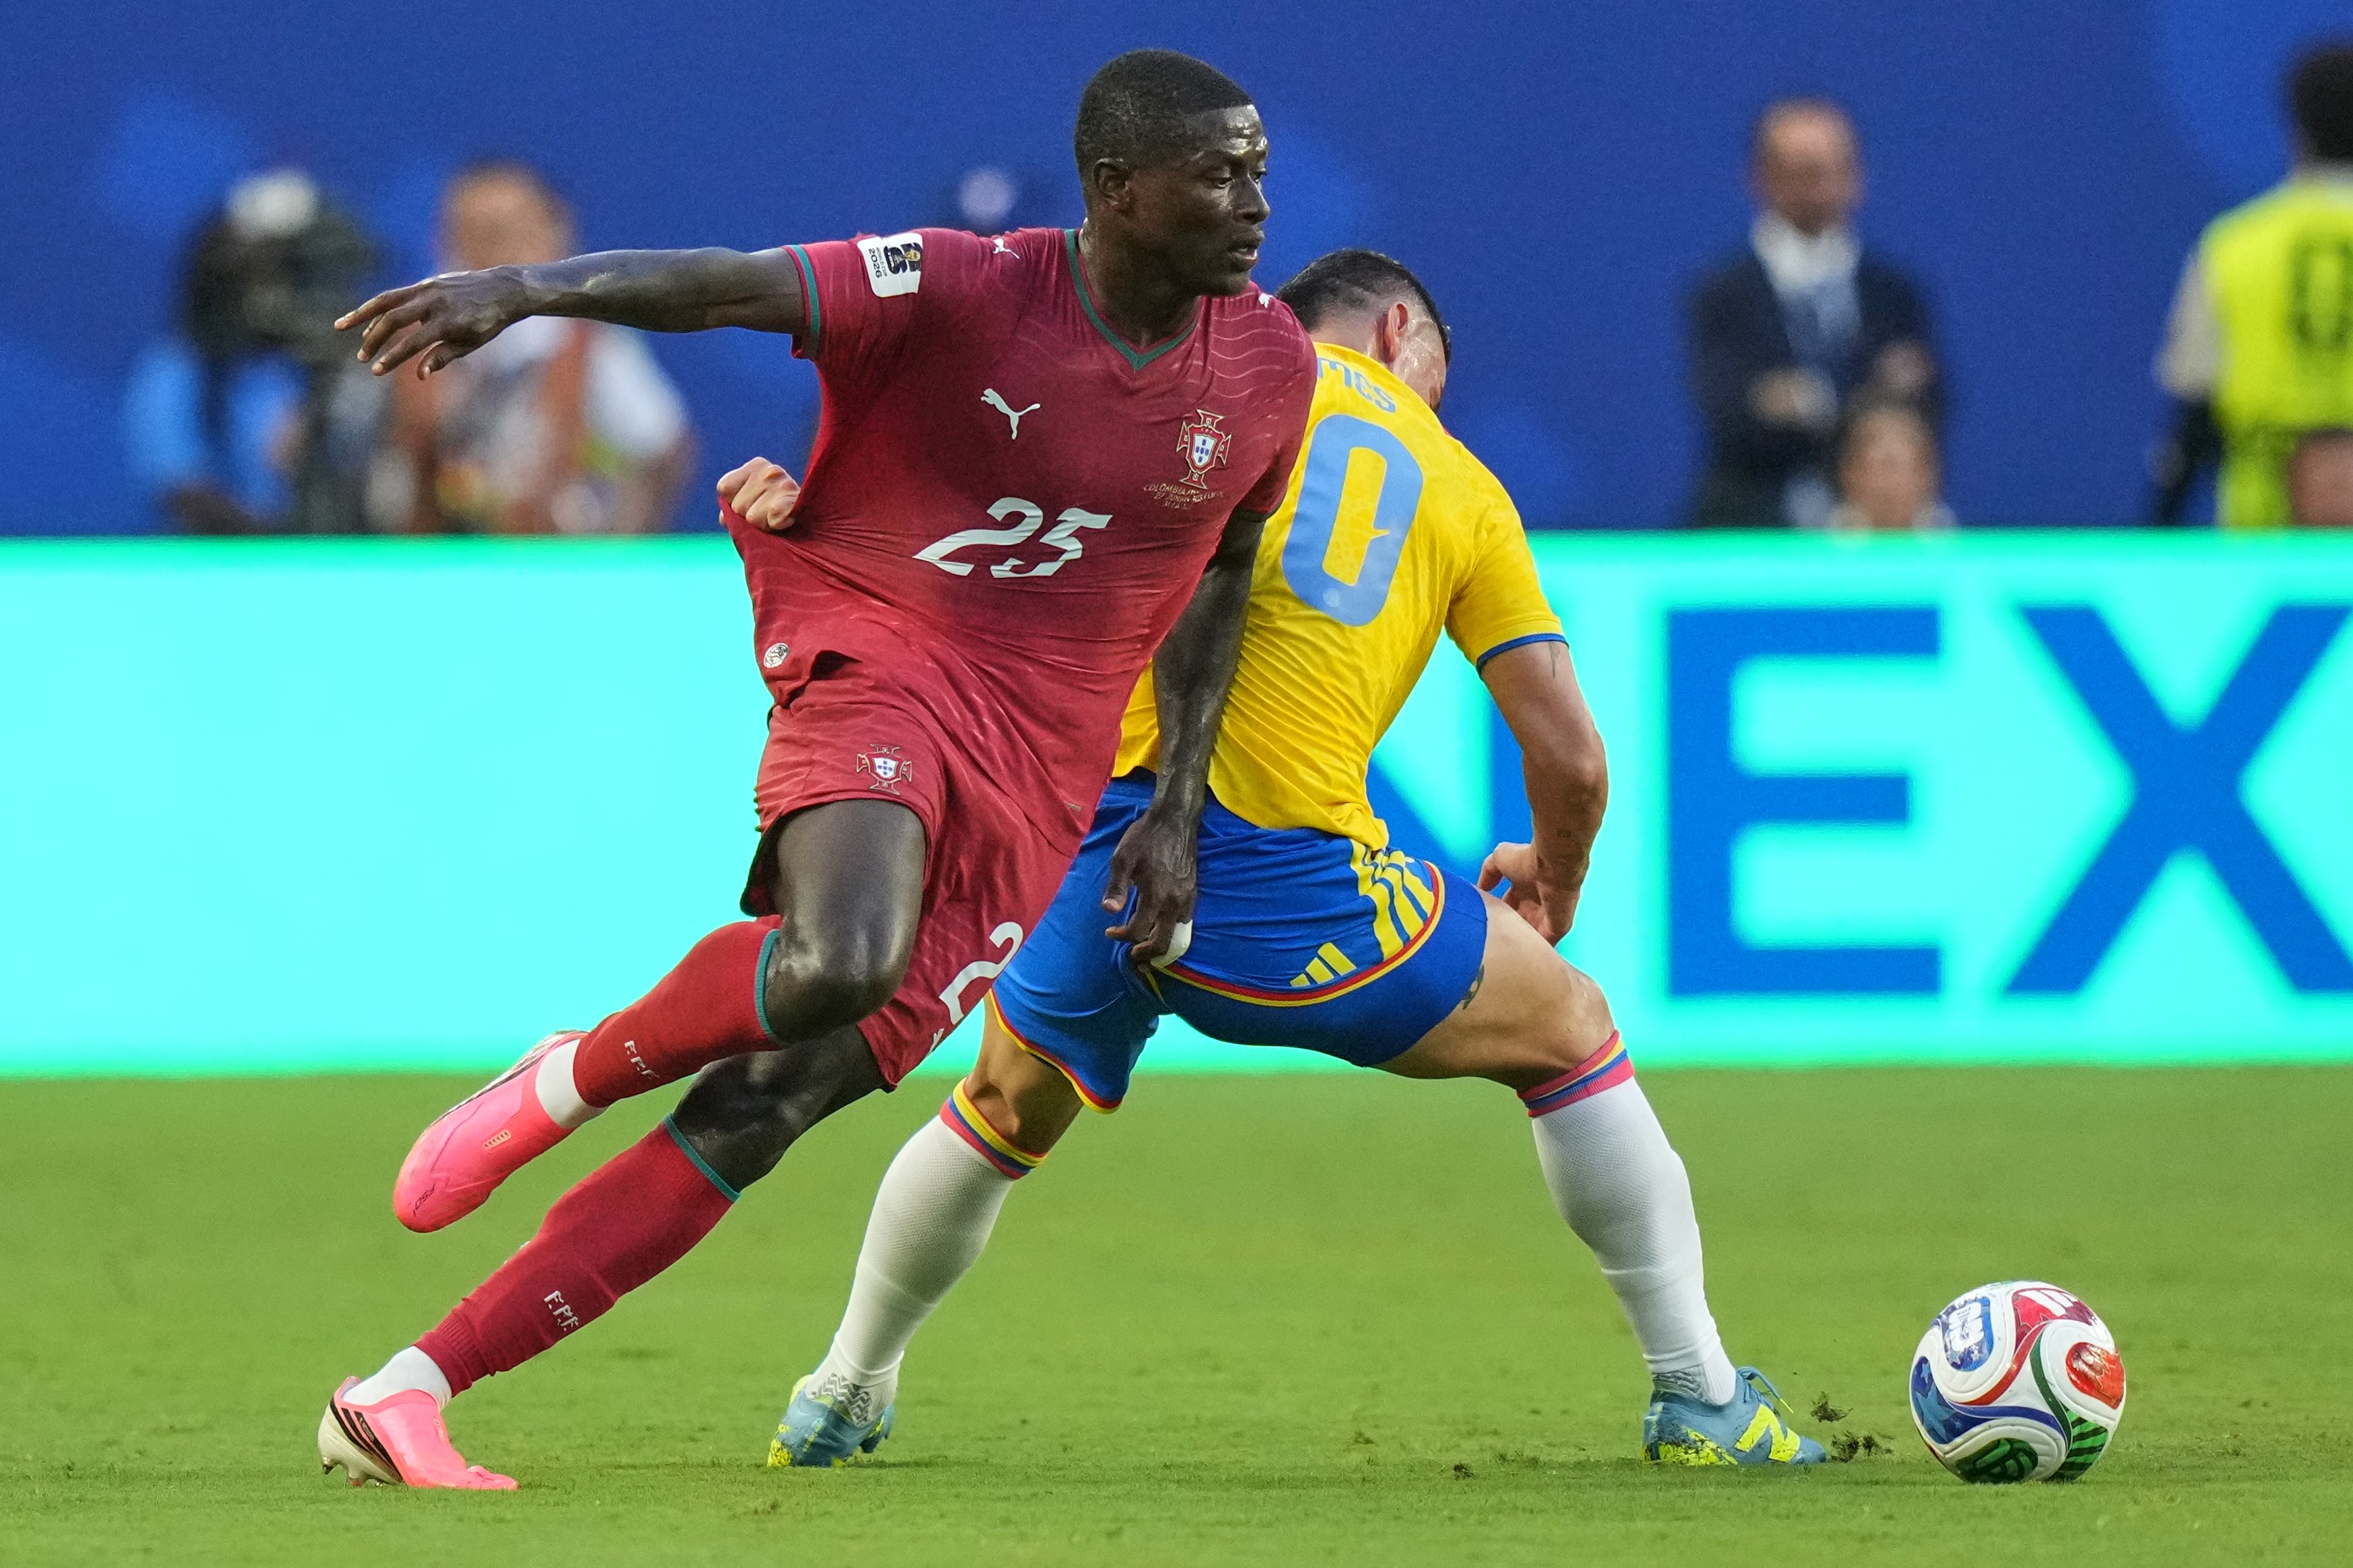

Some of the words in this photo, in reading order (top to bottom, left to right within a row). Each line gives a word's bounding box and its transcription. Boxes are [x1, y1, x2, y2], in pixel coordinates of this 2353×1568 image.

[869, 248, 882, 278] 2026
[876, 247, 884, 265] WORLD
[912, 497, 1113, 578] 25
[1281, 414, 1423, 627] 0
[926, 922, 1023, 1056] 2
